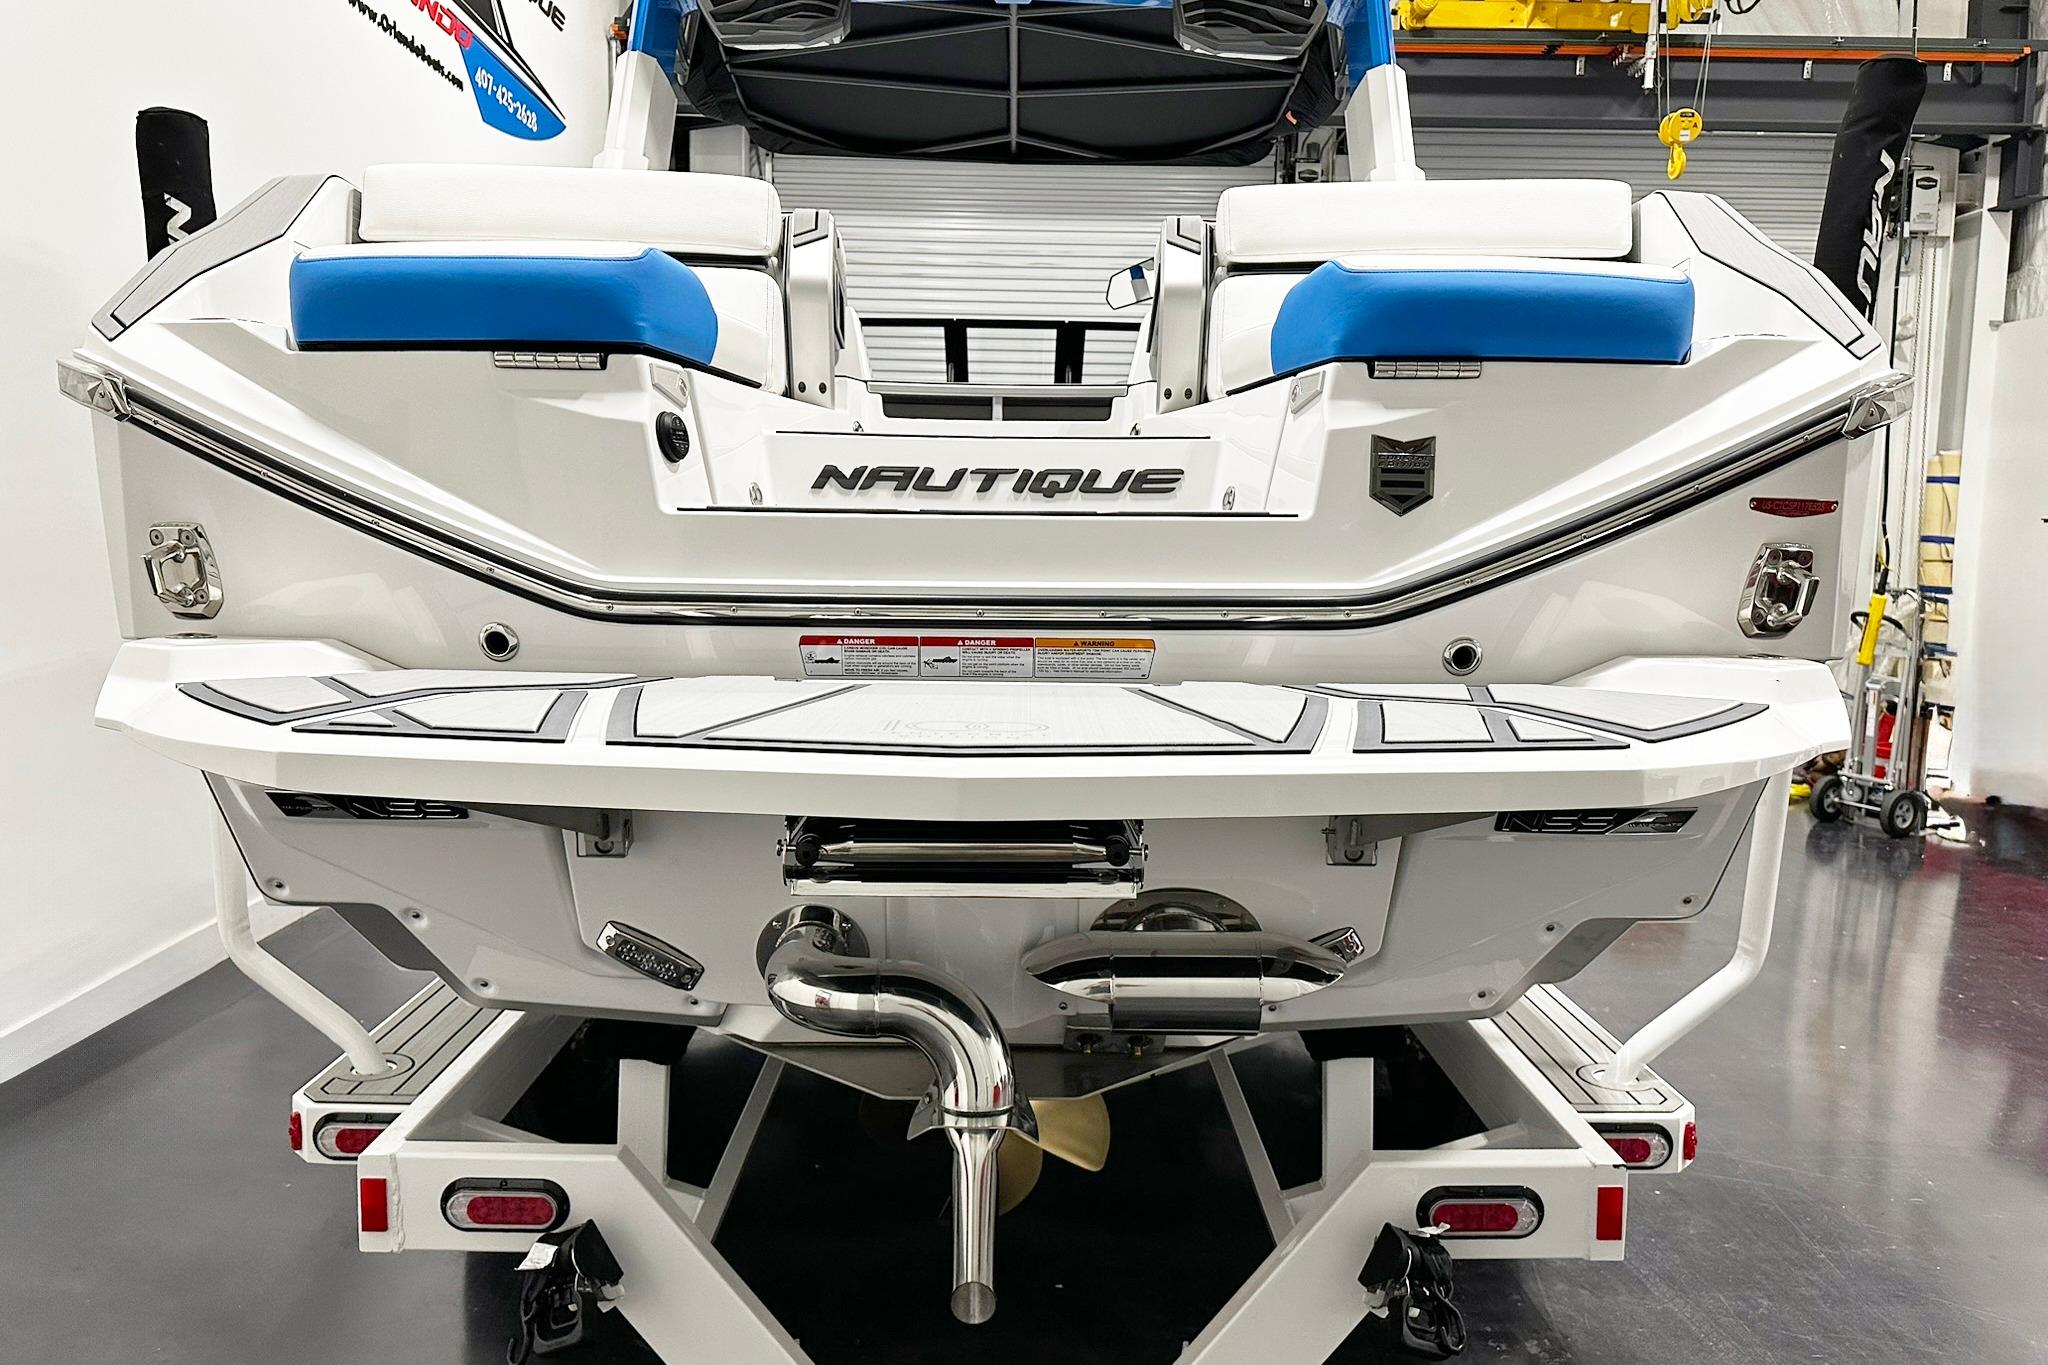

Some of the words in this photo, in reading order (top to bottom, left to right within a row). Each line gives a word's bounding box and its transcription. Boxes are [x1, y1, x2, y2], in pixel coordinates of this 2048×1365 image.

[411, 0, 473, 49] NDO
[528, 0, 566, 32] UE
[474, 66, 538, 133] 407-425-2628
[811, 464, 1185, 498] NAUTIQUE
[1502, 811, 1618, 833] NSS
